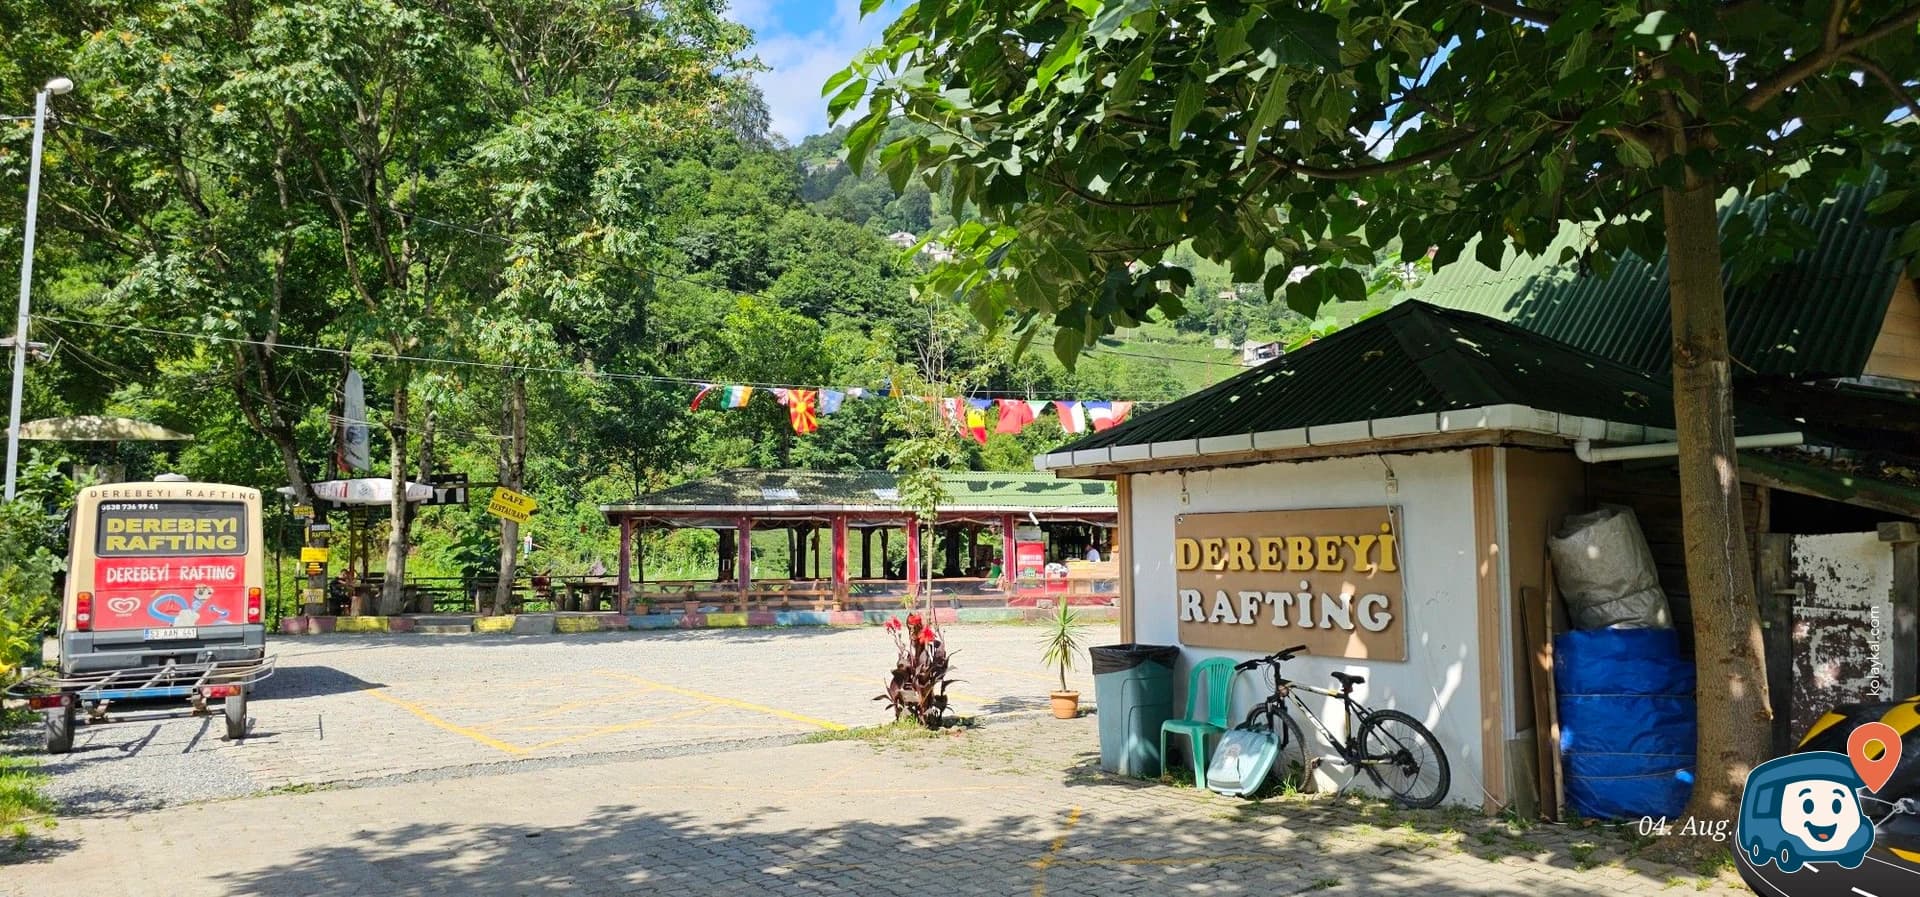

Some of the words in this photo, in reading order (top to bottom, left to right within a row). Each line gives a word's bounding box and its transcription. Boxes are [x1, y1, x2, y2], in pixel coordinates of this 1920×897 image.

[90, 489, 171, 498] DEREBEYI
[185, 489, 256, 500] RAFTING
[502, 492, 525, 505] CAFE
[491, 502, 529, 521] RESTAURANT
[106, 533, 237, 551] RAFTİNG
[1175, 521, 1398, 573] DEREBEYİ
[106, 563, 169, 583] DEREBEYİ
[179, 564, 236, 581] RAFTING
[1179, 580, 1392, 633] RAFTİNG
